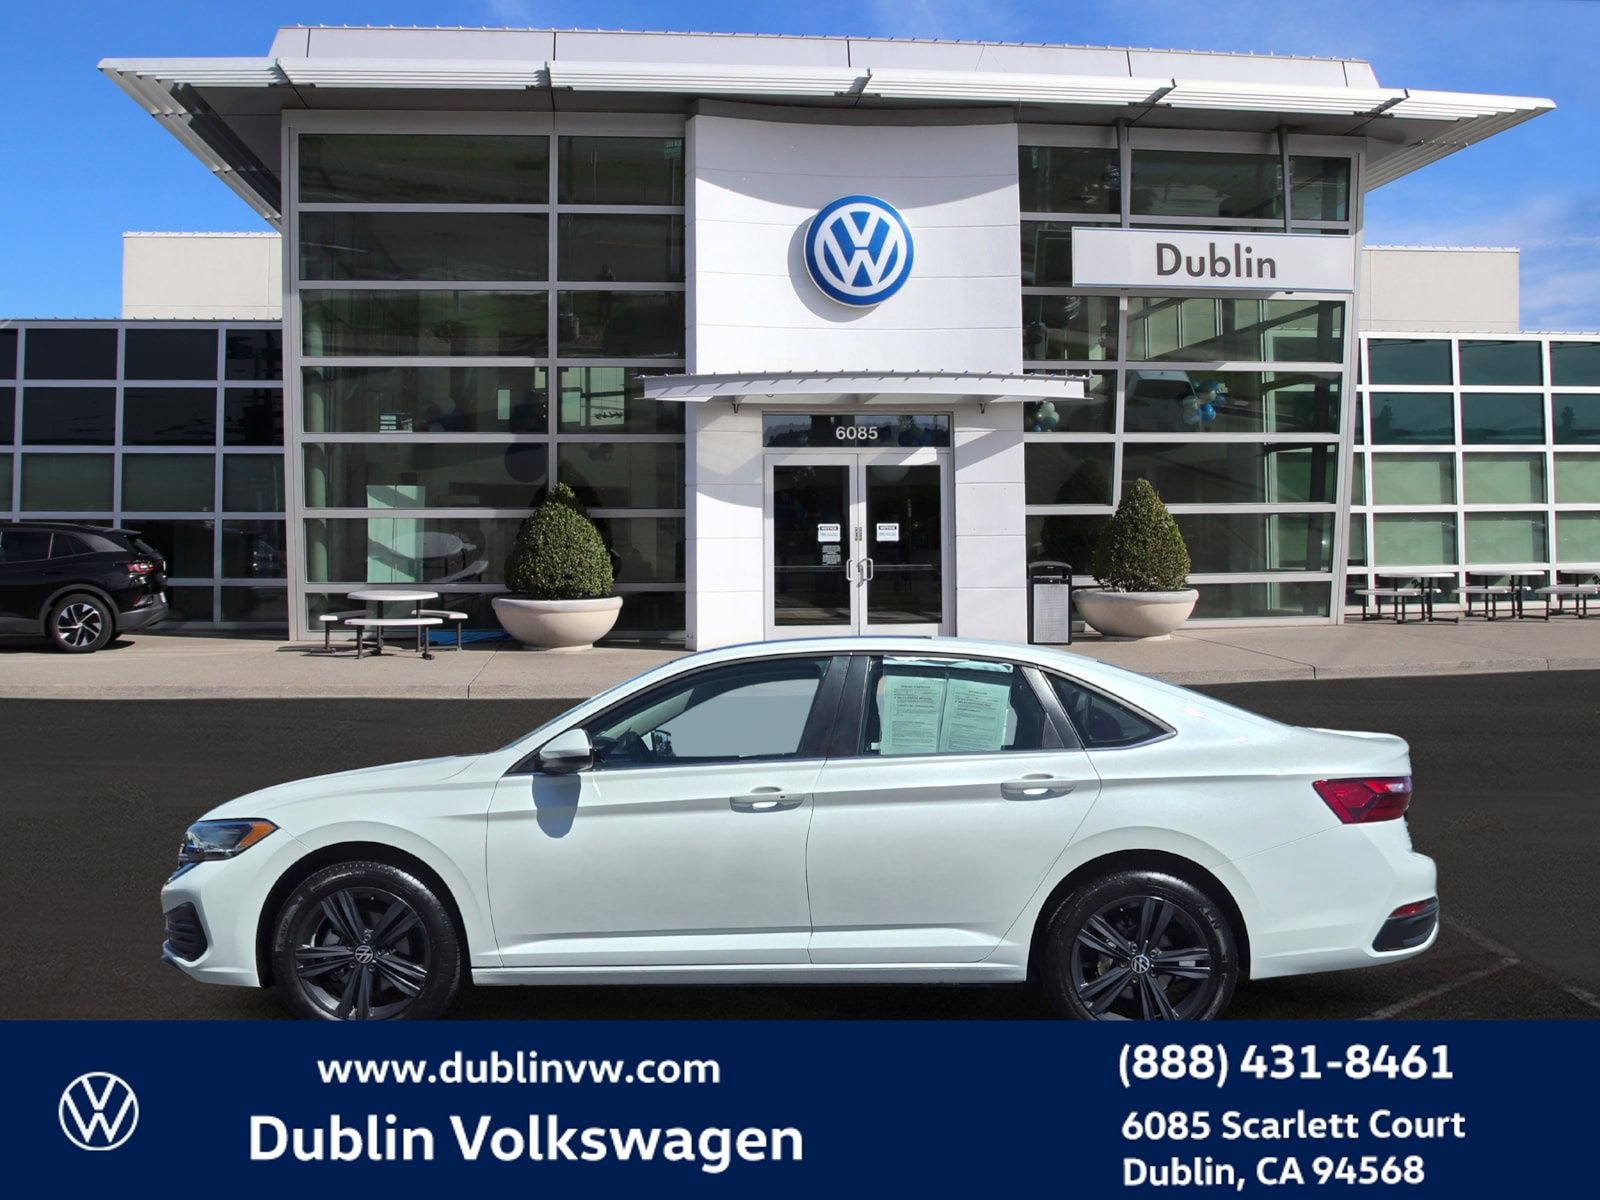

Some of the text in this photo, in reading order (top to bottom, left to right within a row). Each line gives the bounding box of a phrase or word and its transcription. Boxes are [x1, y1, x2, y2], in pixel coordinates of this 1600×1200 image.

[814, 202, 908, 297] VW
[1155, 242, 1278, 279] Dublin
[835, 426, 879, 441] 6085
